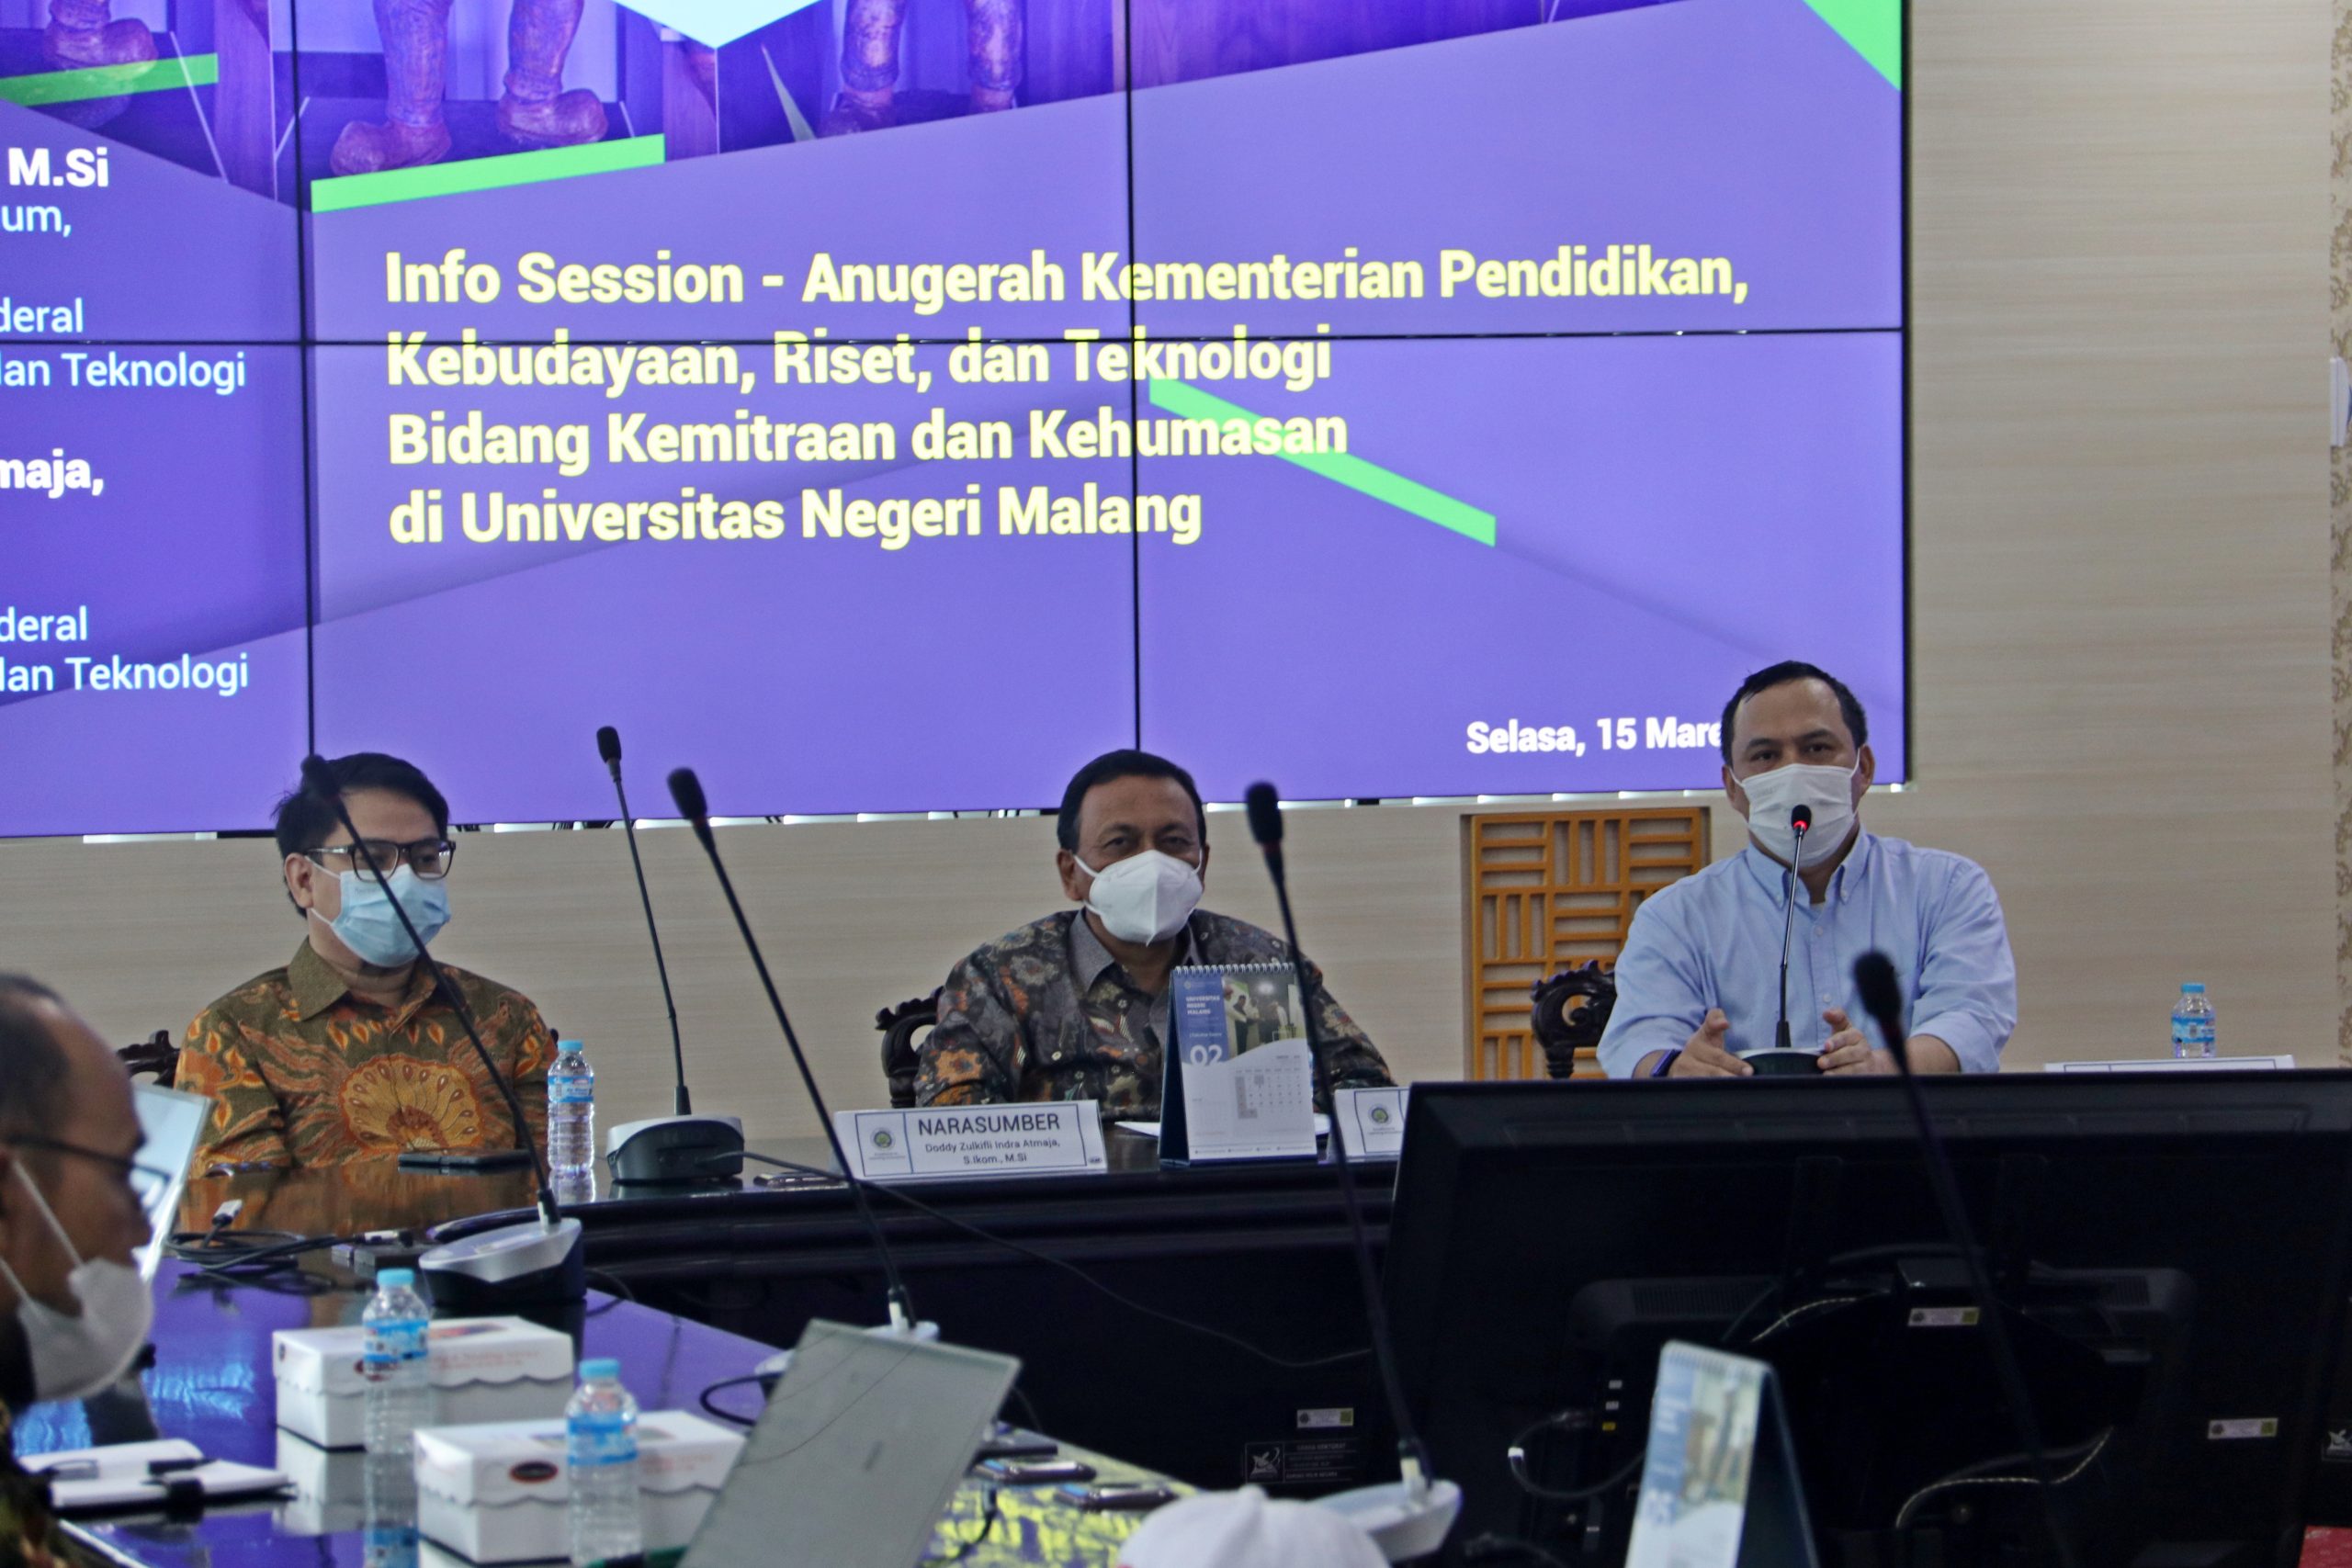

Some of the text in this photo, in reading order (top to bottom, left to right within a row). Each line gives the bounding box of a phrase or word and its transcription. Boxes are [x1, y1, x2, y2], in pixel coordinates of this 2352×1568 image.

[8, 146, 108, 187] M.Si
[386, 243, 1748, 316] Info Session - Anugerah Kementerian Pendidikan,
[0, 351, 245, 396] an Teknologi
[387, 322, 1331, 399] Kebudayaan, Riset, dan Teknologi
[389, 407, 1349, 478] Bidang Kemitraan dan Kehumasan
[389, 481, 1202, 551] di Universitas Negeri Malang
[64, 652, 248, 697] Teknologi
[1466, 716, 1722, 758] Selasa, 15 Mare
[919, 1113, 1060, 1135] NARASUMBER
[925, 1137, 1060, 1153] Doddy Zulkifli Indra Atmaja,
